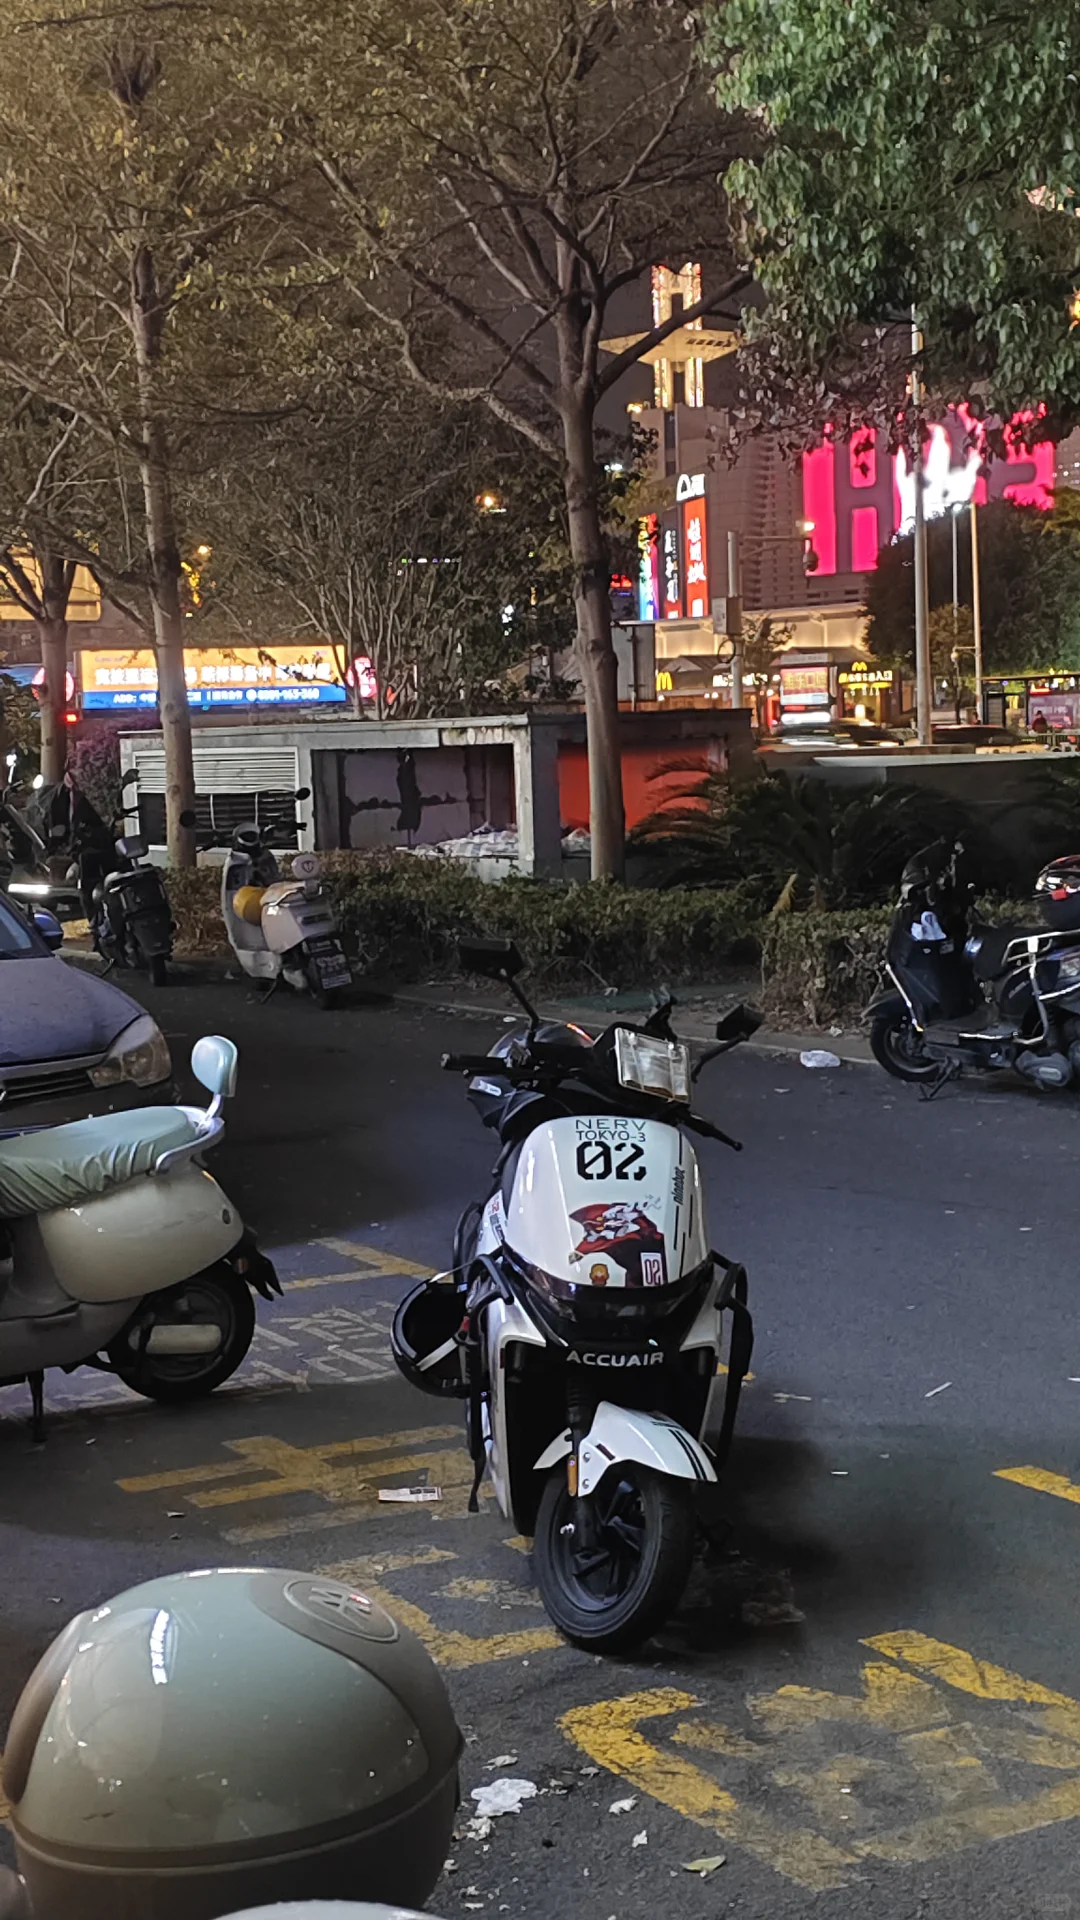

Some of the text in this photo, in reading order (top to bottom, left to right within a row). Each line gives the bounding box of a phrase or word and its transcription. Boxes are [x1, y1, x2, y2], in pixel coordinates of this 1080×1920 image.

[575, 1118, 647, 1132] NERV
[576, 1130, 647, 1143] TOKYO-3
[576, 1141, 647, 1182] 02
[643, 1258, 662, 1286] 02
[566, 1350, 664, 1367] ACCUAIR
